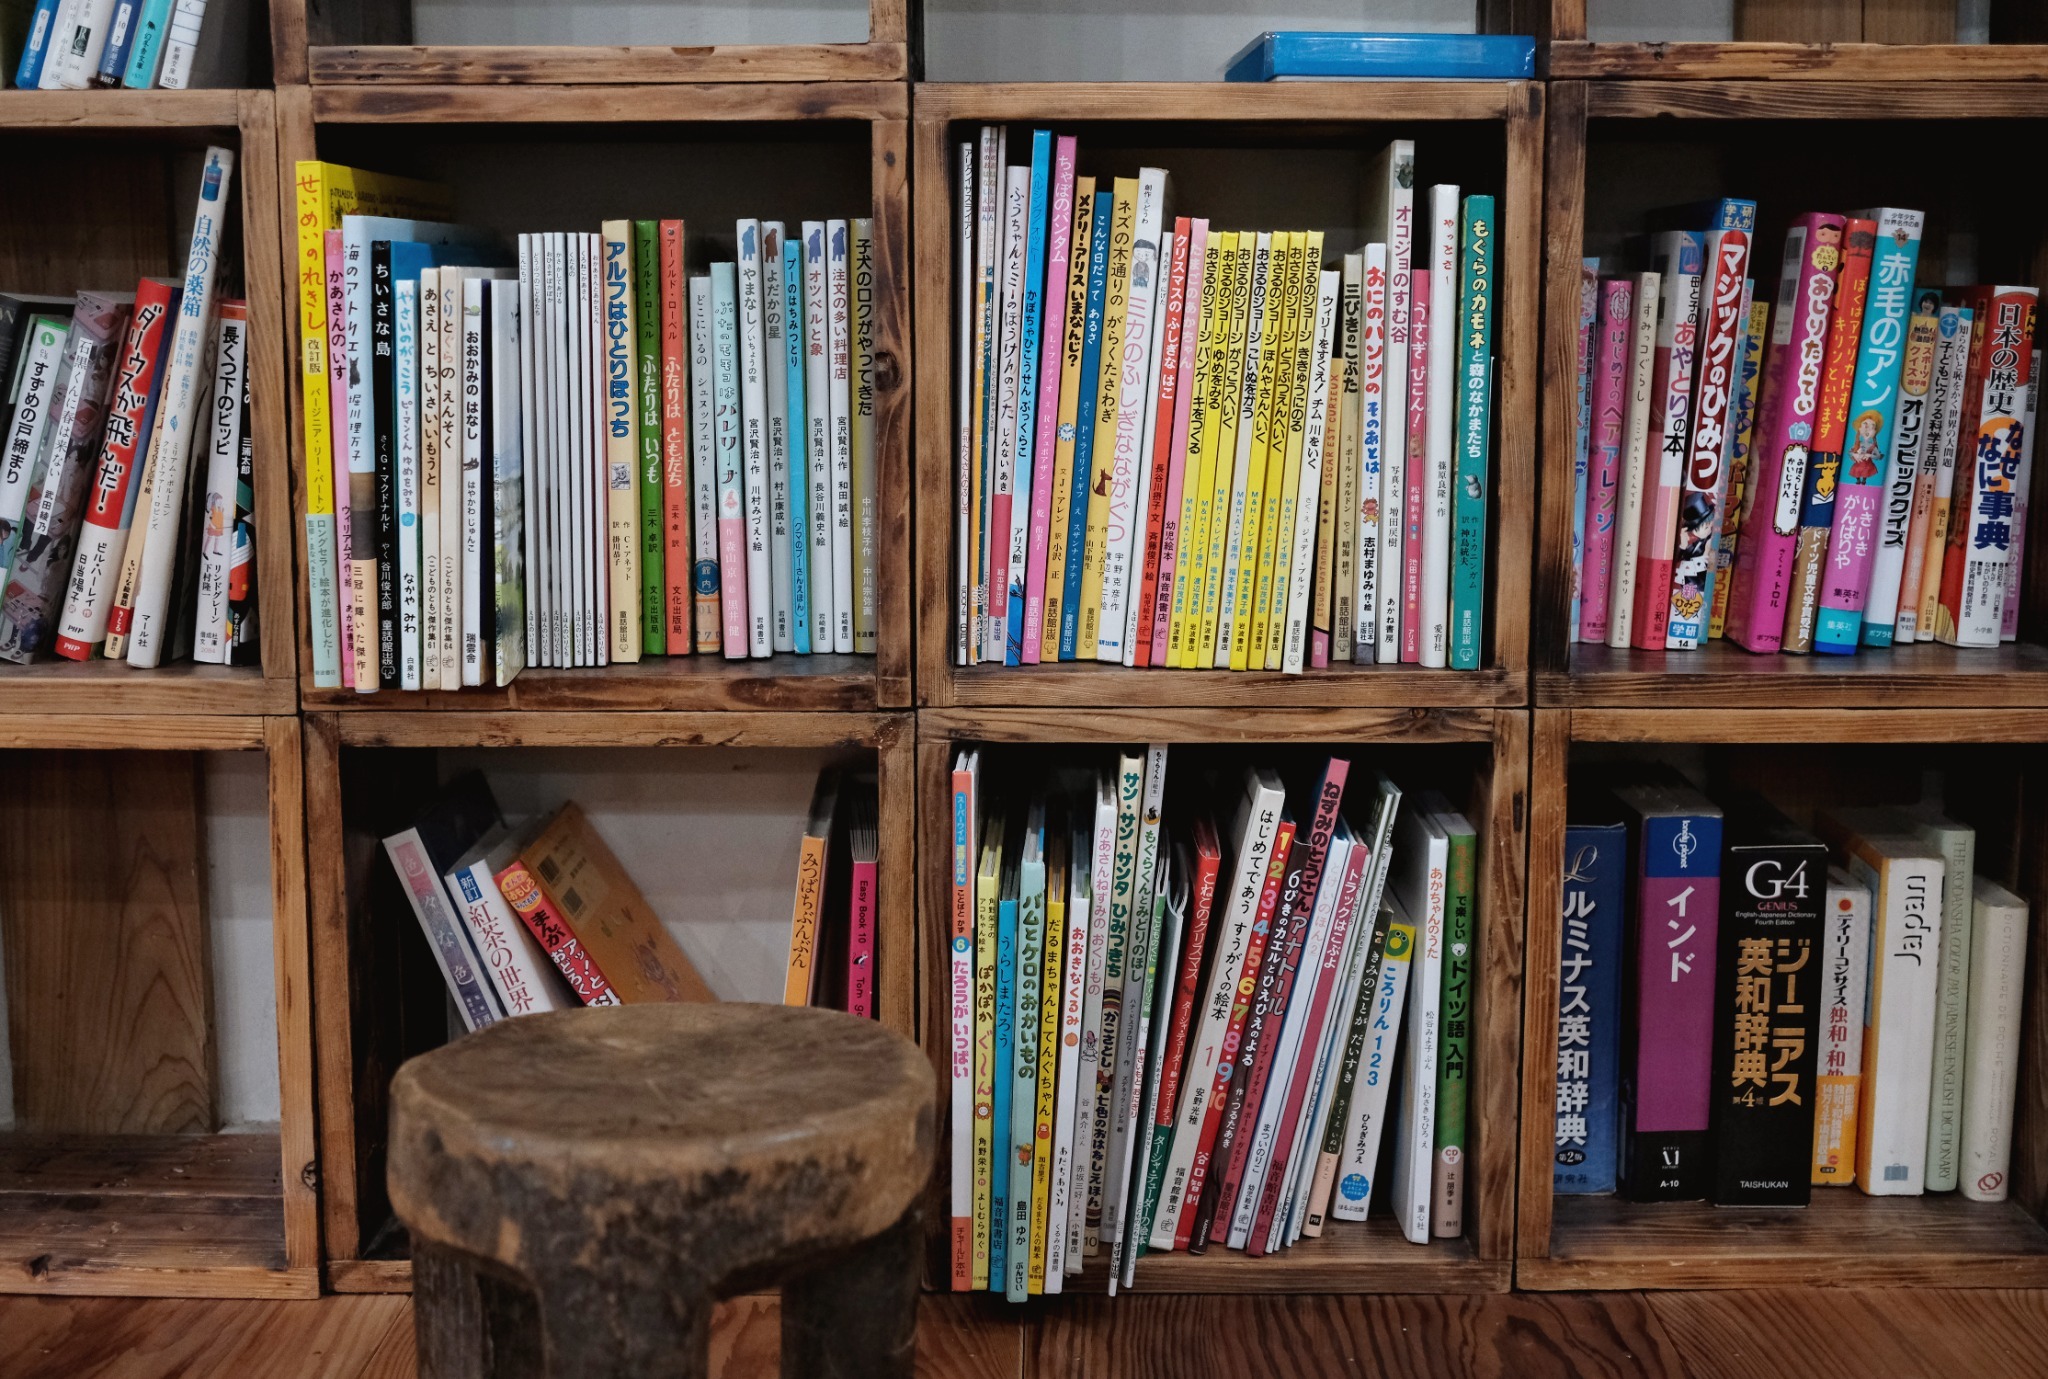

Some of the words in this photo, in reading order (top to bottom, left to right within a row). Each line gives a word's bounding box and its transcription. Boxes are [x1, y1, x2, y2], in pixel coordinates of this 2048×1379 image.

[1051, 154, 1073, 263] ちゃぼのバンタム
[1072, 193, 1091, 287] メアリー・アリス
[1723, 217, 1752, 229] まんが
[1724, 205, 1753, 217] 学研
[182, 214, 213, 318] 自然の薬箱
[297, 174, 326, 330] せいめいのれきし
[1091, 214, 1107, 302] こんな日だって
[1109, 200, 1132, 306] ネズの木通りの
[1168, 233, 1188, 314] クリスマスの
[1390, 205, 1411, 344] オコジョのすむ谷
[329, 270, 346, 381] かあさんのいす
[344, 243, 361, 352] 海のアトリエ
[374, 263, 391, 357] ちいさな島
[643, 239, 654, 339] アーノルド・ローベル
[666, 238, 677, 340] アーノルド・ローベル
[766, 269, 782, 340] よだかの星
[786, 258, 799, 368] プーのはちみつとり
[809, 270, 824, 357] オツベルと象
[832, 268, 848, 380] 注文の多い料理店
[1179, 242, 1203, 369] たまごのあかちゃん
[1199, 247, 1220, 343] おさるのジョージ
[1214, 249, 1236, 345] おさるのジョージ
[1230, 247, 1251, 344] おさるのジョージ
[1249, 247, 1270, 344] おさるのジョージ
[1264, 248, 1286, 346] おさるのジョージ
[1282, 246, 1303, 343] おさるのジョージ
[1299, 246, 1320, 343] おさるのジョージ
[308, 339, 321, 374] 改訂版
[396, 289, 413, 395] やさいのがっこう
[441, 288, 455, 379] ぐりとぐらの
[696, 294, 707, 366] どこにいるの
[856, 239, 873, 417] 子犬のロクがやってきた
[1020, 290, 1037, 397] かぼちゃひこうせん
[1087, 308, 1100, 345] あるさ
[1164, 317, 1181, 370] ふしぎな
[1343, 283, 1361, 394] 三びきのこぶた
[1364, 265, 1386, 395] おにのパンツの
[1466, 219, 1489, 459] もぐらのカモネと森のなかまたち
[1636, 304, 1652, 402] すみっコぐらし
[1694, 243, 1747, 479] マジックのひみつ
[1797, 277, 1833, 412] おしりたんてい
[1862, 252, 1912, 407] 赤毛のアン
[1984, 302, 2021, 416] 日本の歴史
[216, 325, 240, 456] 長くつ下のピッピ
[466, 331, 479, 396] おおかみの
[642, 354, 658, 427] ふたりは
[665, 356, 681, 419] ふたりは
[1101, 314, 1124, 424] がらくたさわぎ
[1161, 374, 1175, 400] はこ
[1208, 348, 1226, 410] ゆめをみる
[1222, 347, 1242, 430] がっこうへいく
[1242, 347, 1260, 420] こいぬをかう
[1255, 348, 1276, 444] ほんやさんへいく
[1272, 346, 1293, 453] どうぶつえんへいく
[1290, 346, 1310, 433] ききゅうにのる
[1328, 373, 1339, 423] CURIEUX
[1662, 321, 1697, 457] あやとりの本
[1819, 316, 1847, 439] キリンといいます
[7, 361, 49, 483] すずめの戸締まり
[50, 339, 93, 476] 石黒くんに春は来ない
[349, 394, 362, 462] 堀川理万子
[441, 390, 455, 449] えんそく
[466, 401, 479, 440] はなし
[772, 416, 783, 471] 宮沢賢治・作
[1108, 295, 1147, 543] ミカのふしぎなながぐつ
[1311, 398, 1324, 421] チム
[1327, 427, 1336, 448] EST
[310, 388, 325, 513] バージニア・リー・バートン
[645, 437, 659, 484] いつも
[667, 427, 683, 488] ともだち
[749, 418, 760, 475] 宮沢賢治・作
[813, 417, 824, 473] 宮沢賢治・作
[1307, 424, 1321, 470] 川をいく
[1324, 450, 1335, 486] OSCAR
[1885, 399, 1924, 551] オリンピッククイズ
[37, 489, 54, 533] 武田綾乃
[402, 456, 414, 508] ゆめをみる
[751, 485, 763, 552] 川村みづえ・絵
[774, 481, 786, 536] 村上康成・絵
[815, 482, 826, 547] 長谷川義史・絵
[1011, 526, 1023, 565] アリス館
[1163, 520, 1176, 562] 幼児絵本
[1974, 490, 2016, 552] 事典
[85, 542, 107, 607] ビル・ハーレイ
[210, 563, 226, 624] リンドグレーン
[380, 561, 393, 610] 谷川俊太郎
[1156, 571, 1172, 623] 福音館書店
[1362, 536, 1376, 591] 志村まゆみ
[67, 624, 84, 634] PHP
[138, 614, 151, 648] マール社
[381, 619, 393, 666] 童話館出版
[650, 584, 659, 634] 文化出版局
[672, 584, 682, 635] 文化出版局
[757, 616, 765, 645] 岩崎書店
[818, 613, 826, 641] 岩崎書店
[1026, 596, 1040, 641] 童話館出版
[1170, 620, 1181, 650] 岩波書店
[1384, 598, 1396, 644] あかね書房
[1433, 624, 1443, 652] 愛育社
[1678, 639, 1689, 648] 14
[63, 642, 81, 652] PHP
[466, 633, 476, 664] 瑞雲舎
[1114, 772, 1140, 898] サン・サン・サンタ
[1240, 809, 1275, 916] はじめてであう
[1955, 839, 1967, 867] THE
[460, 874, 481, 903] 新訂
[792, 852, 819, 969] みつばちぶんぶん
[858, 879, 869, 903] Easy
[1130, 829, 1157, 983] もぐらくんとみどりのほし
[1426, 866, 1443, 960] あかちゃんのうた
[1735, 911, 1788, 919] English-Japanese
[1788, 911, 1817, 919] Dictionary
[1744, 859, 1810, 900] G4
[1757, 901, 1798, 911] GENIUS
[1951, 870, 1966, 935] KODANSHA
[858, 906, 868, 928] Book
[858, 932, 867, 944] 10
[1107, 902, 1128, 979] ひみつきち
[1323, 868, 1360, 970] トラックはこぶよ
[1666, 885, 1698, 983] インド
[1893, 874, 1932, 967] Japan
[467, 900, 534, 1014] 紅茶の世界
[855, 976, 865, 999] Tom
[953, 959, 969, 1019] たろうが
[998, 935, 1012, 1049] うらしまたろう
[1018, 892, 1043, 1080] バムとケロのおかいもの
[1066, 926, 1086, 1027] おおきなくるみ
[1210, 922, 1248, 1022] すうがくの絵本
[1241, 869, 1303, 1067] 6ぴきのカエルとひえひえのよる
[1946, 976, 1960, 999] PAX
[1949, 937, 1962, 976] COLOR
[978, 963, 995, 1024] ぽかぽか
[1038, 918, 1062, 1117] だるまちゃんとてんぐちゃん
[1373, 965, 1397, 1031] ころりん
[1555, 890, 1597, 1147] ルミナス英和辞典
[1731, 937, 1774, 1089] 英和辞典
[1768, 938, 1812, 1107] ジーニアス
[1445, 1043, 1465, 1080] 入門
[1937, 1110, 1955, 1181] DICTIONARY
[1739, 1179, 1790, 1189] TAISHUKAN
